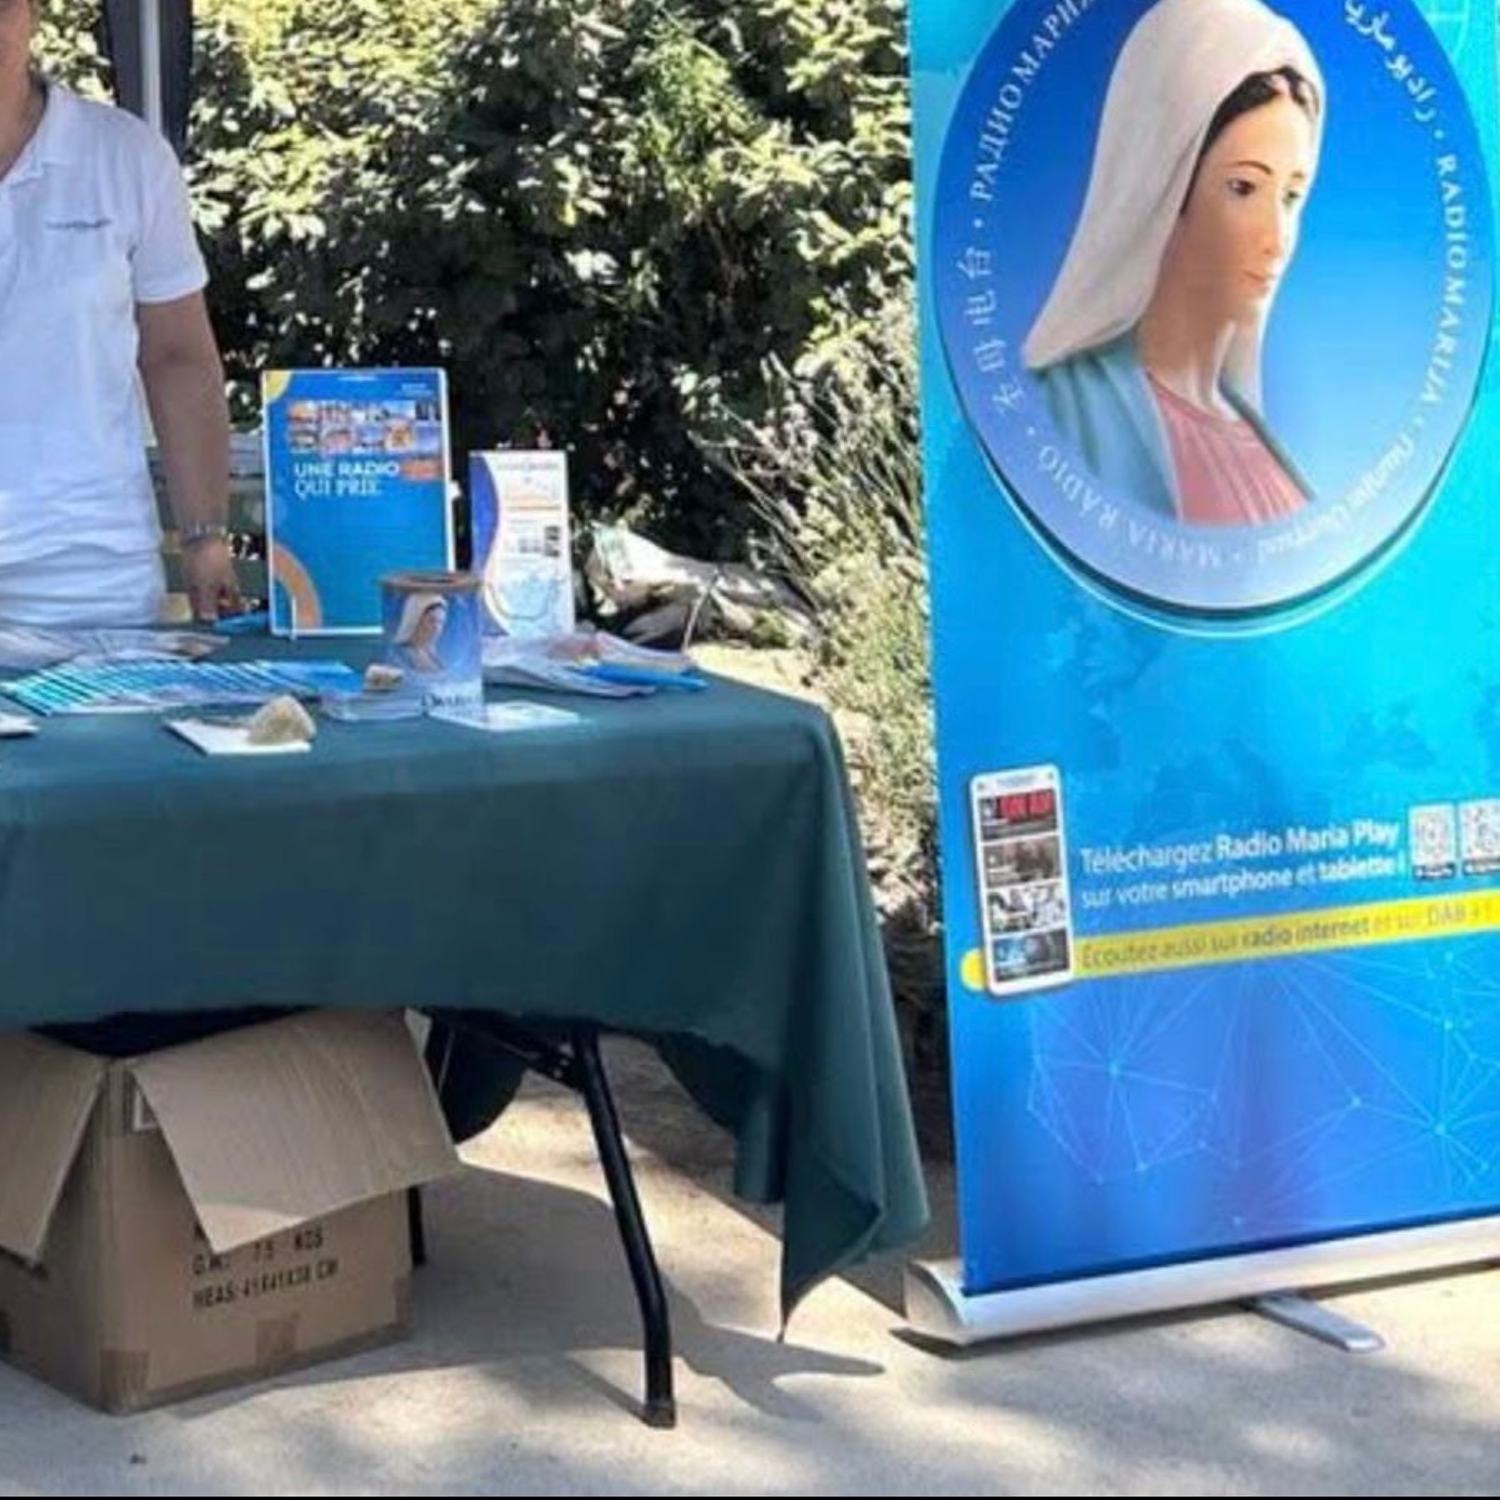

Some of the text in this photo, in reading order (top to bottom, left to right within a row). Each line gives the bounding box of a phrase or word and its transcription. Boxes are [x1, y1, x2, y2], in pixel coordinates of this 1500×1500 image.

[294, 461, 400, 477] UNE RADIO
[294, 477, 331, 500] QUI
[1215, 829, 1283, 862] Radio
[1285, 822, 1349, 852] Maria
[1352, 817, 1400, 849] Play
[1081, 887, 1113, 909] sur
[1116, 882, 1169, 905] votre
[1172, 867, 1294, 900] smartphone
[1241, 923, 1293, 950] radio
[1295, 916, 1370, 942] internet
